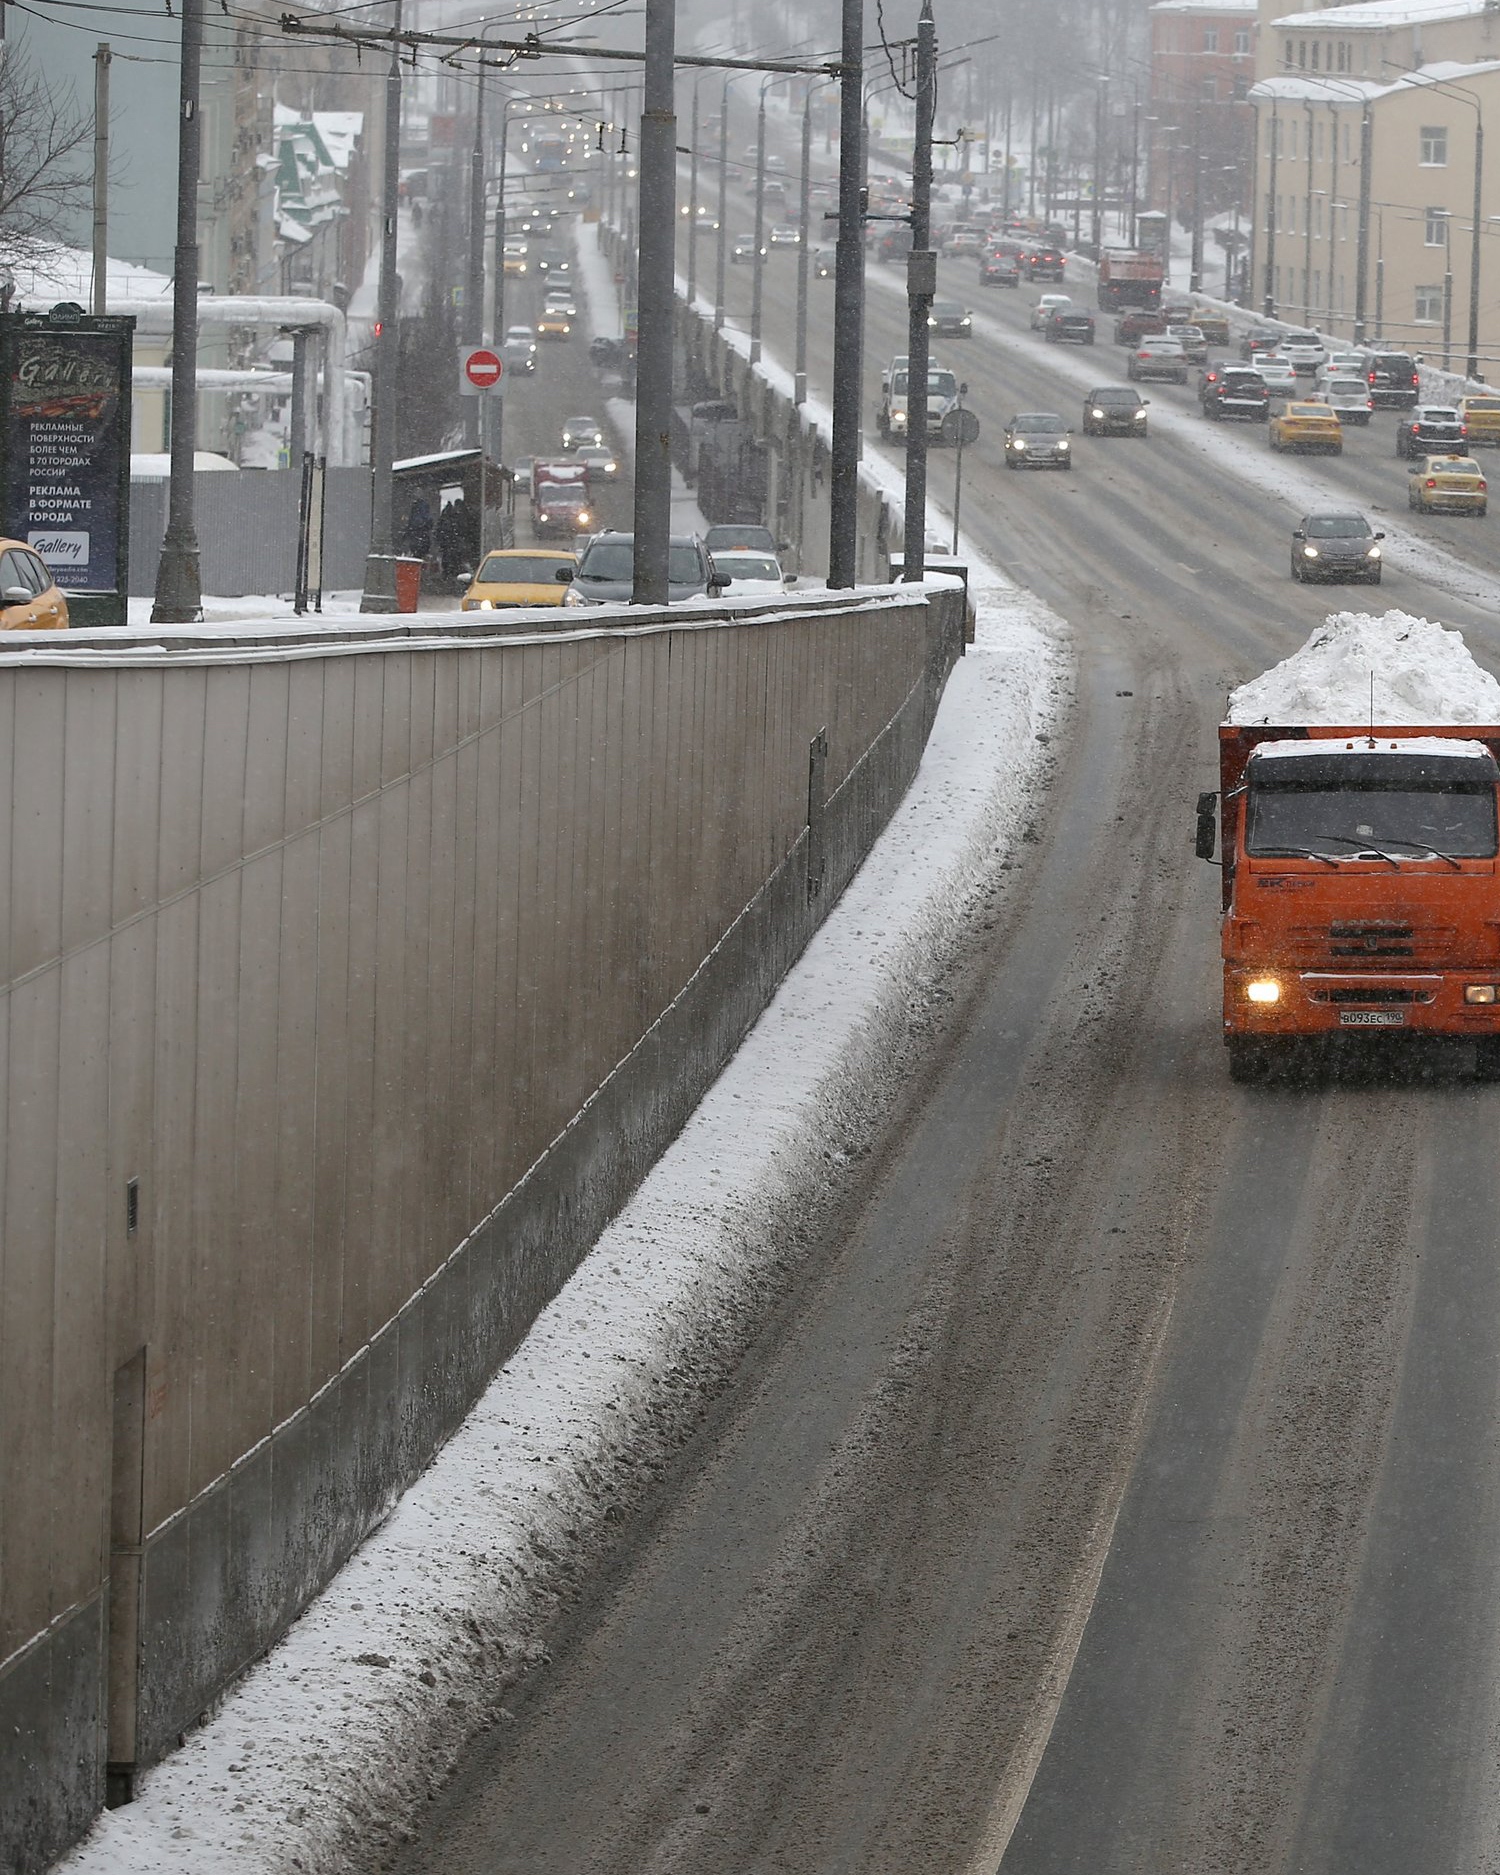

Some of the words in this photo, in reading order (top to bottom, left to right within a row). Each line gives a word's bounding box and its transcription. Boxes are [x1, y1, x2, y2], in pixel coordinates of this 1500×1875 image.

[51, 313, 78, 321] ОЛИМП
[19, 356, 112, 388] Gallery
[30, 423, 84, 432] РЕКЛАМНЫЕ
[30, 434, 94, 443] ПОВЕРХНОСТИ
[30, 445, 57, 454] БОЛЕЕ
[59, 446, 78, 454] ЧЕМ
[29, 457, 35, 465] В
[37, 457, 47, 465] 70
[49, 457, 91, 466] ГОРОДАХ
[29, 468, 66, 476] РОССИИ
[29, 486, 81, 496] РЕКЛАМА
[29, 499, 36, 508] В
[38, 499, 92, 509] ФОРМАТЕ
[29, 512, 73, 522] ГОРОДА
[33, 539, 81, 559] Gallery
